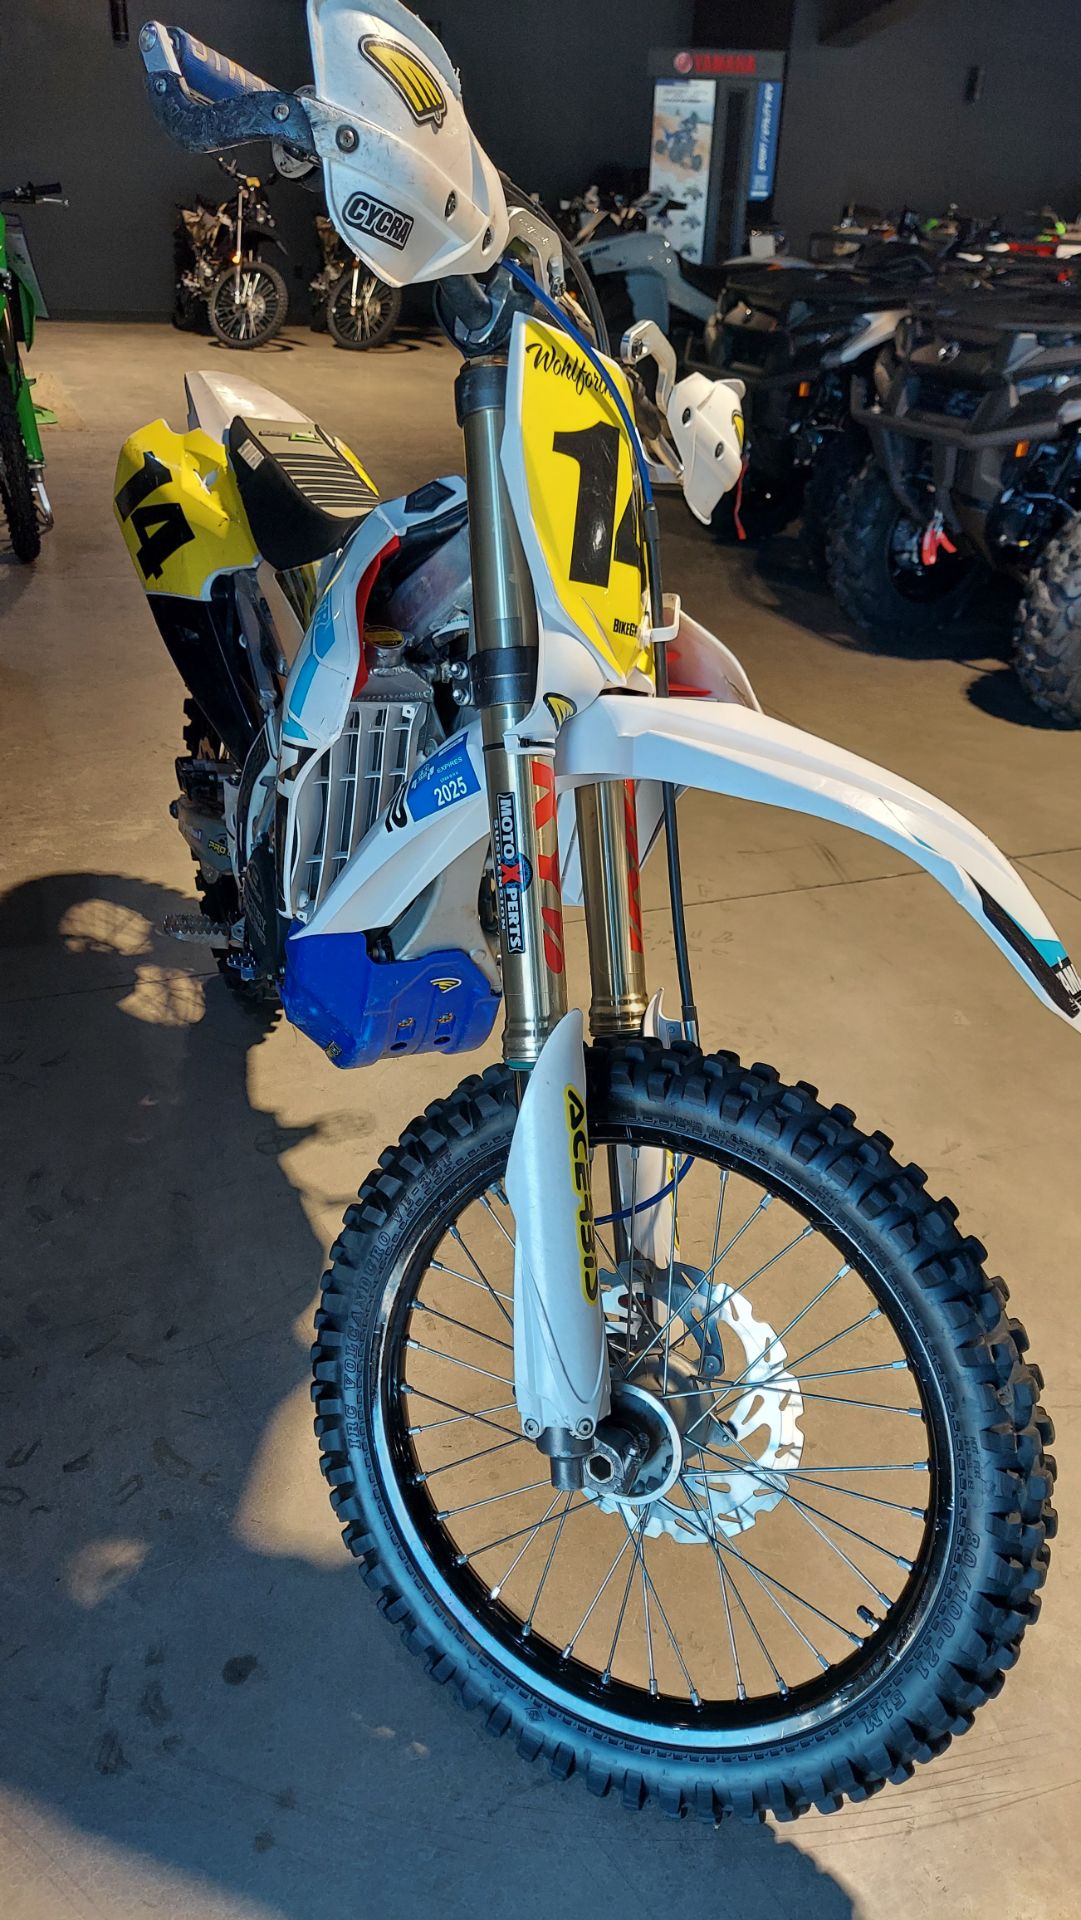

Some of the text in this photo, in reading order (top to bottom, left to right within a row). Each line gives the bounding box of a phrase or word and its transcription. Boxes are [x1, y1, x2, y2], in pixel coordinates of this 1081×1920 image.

[695, 54, 756, 74] YAMAHA
[346, 195, 412, 246] CYCRA
[114, 451, 195, 580] 14
[436, 757, 463, 774] EXPIRES
[434, 776, 467, 806] 2025
[344, 1231, 390, 1390] VOLCANDURO
[345, 1404, 361, 1449] IRC
[864, 1527, 980, 1735] 80/100-21 51M
